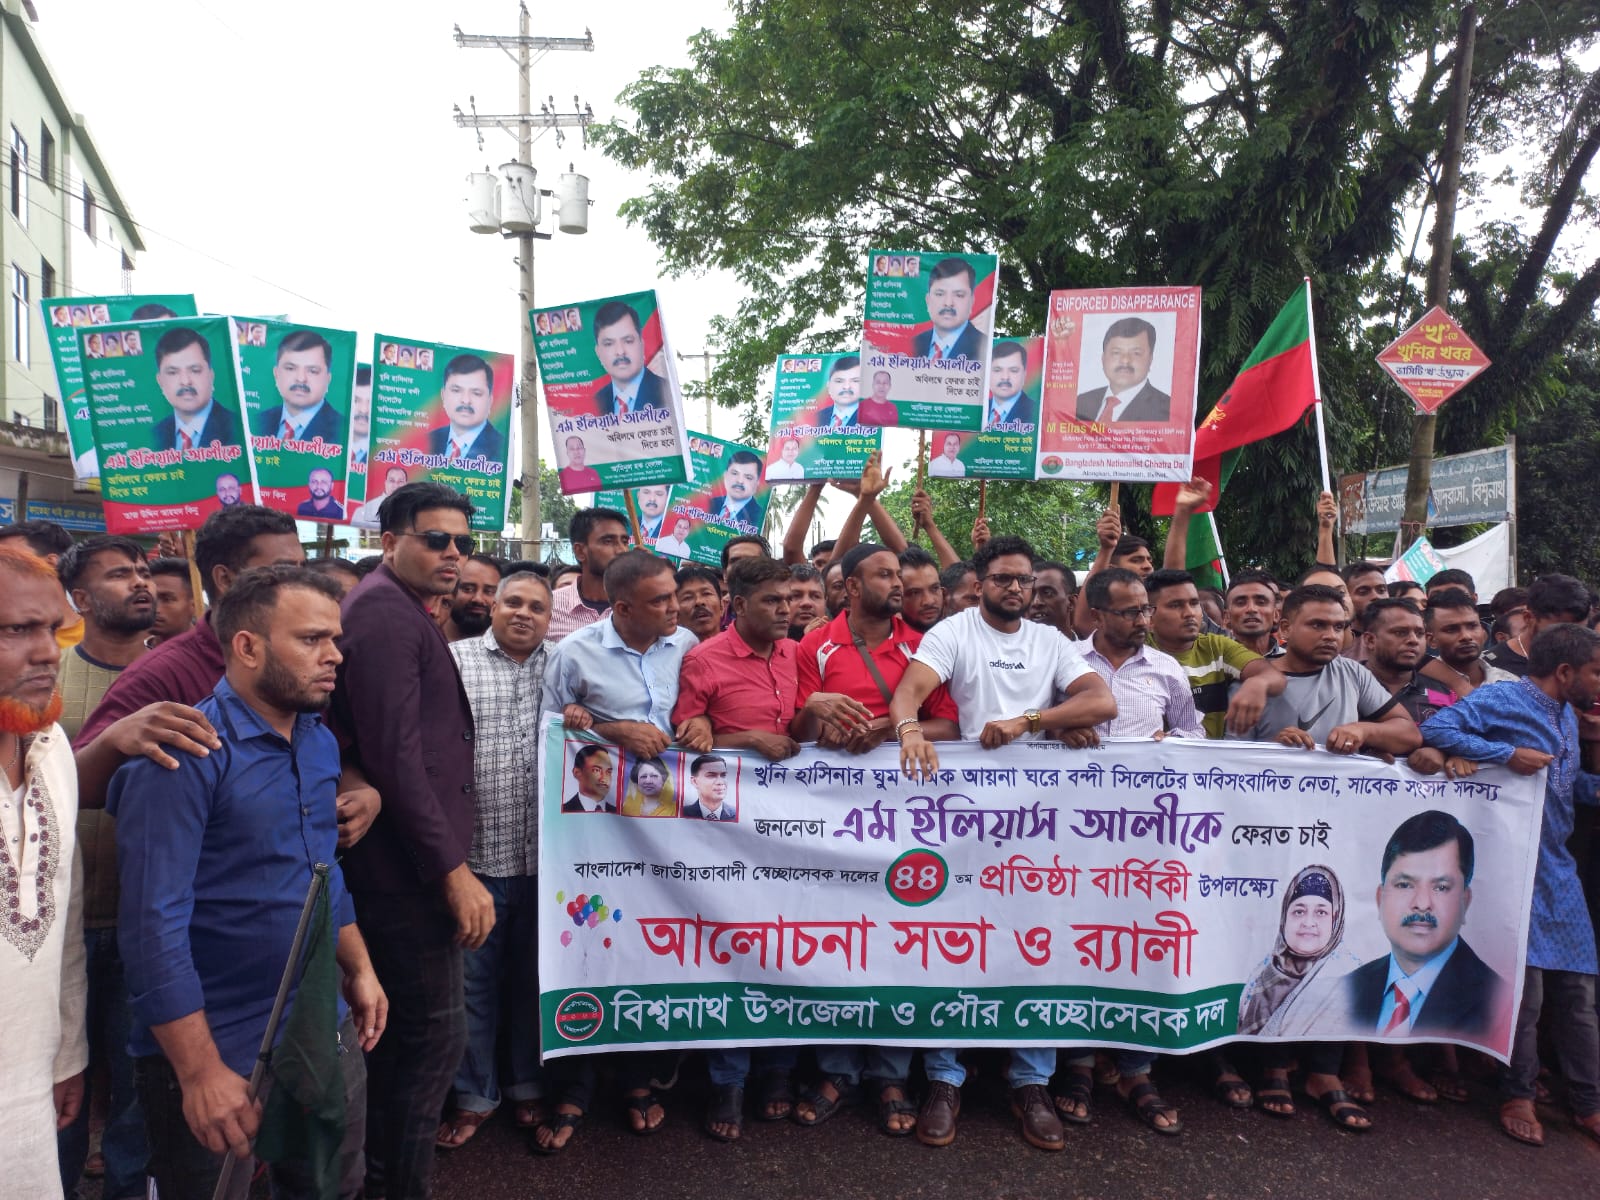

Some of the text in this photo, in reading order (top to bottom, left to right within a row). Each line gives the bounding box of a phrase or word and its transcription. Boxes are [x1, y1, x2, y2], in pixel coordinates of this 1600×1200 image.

[1056, 294, 1196, 312] ENFORCED DISAPPEARANCE
[868, 354, 982, 373] এম ইলিয়াস আলীকে
[1398, 342, 1472, 362] খুশির খবর
[556, 404, 671, 433] এম ইলিয়াস আলীকে
[993, 418, 1035, 435] আলীকে
[1046, 423, 1056, 432] M
[1090, 422, 1105, 433] Ali
[775, 424, 878, 438] এম ইলিয়াস আলীকে
[104, 440, 242, 469] এম ইলিয়াস আলীকে
[284, 436, 342, 458] আলীকে
[374, 449, 503, 476] এম ইলিয়াস আলীকে
[1065, 458, 1104, 469] Bangladesh
[1107, 459, 1142, 468] Nationalist
[1472, 476, 1506, 507] বিশ্বনাথ
[989, 660, 1012, 670] adidas
[754, 763, 788, 788] খুনি
[795, 761, 864, 787] হাসিনার
[871, 768, 900, 791] ঘুম
[962, 766, 1016, 788] আয়না
[1024, 769, 1060, 788] ঘরে
[1066, 762, 1104, 788] বন্দী
[1111, 764, 1189, 790] সিলেটের
[1194, 767, 1293, 794] অবিসংবাদিত
[1298, 774, 1341, 798] নেতা,
[1348, 776, 1401, 796] সাবেক
[1405, 779, 1448, 798] সংসদ
[1453, 781, 1502, 801] সদস্য
[754, 792, 1332, 852] জননেতা এম ইলিয়াস আলীকে ফেরত চাই
[574, 854, 1280, 902] বাংলাদেশ জাতীয়তাবাদী স্বেচ্ছাসেবক দলের ৪৪ তম প্রতিষ্ঠা বার্ষিকী উপলক্ষ্যে
[636, 910, 1199, 979] আলোচনা সভা ও র‍্যালী
[609, 989, 734, 1032] বিশ্বনাথ
[740, 987, 880, 1029] উপজেলা
[890, 1000, 916, 1026] ও
[930, 990, 1006, 1029] পৌর
[1014, 996, 1190, 1038] স্বেচ্ছাসেবক
[1194, 998, 1229, 1032] দল
